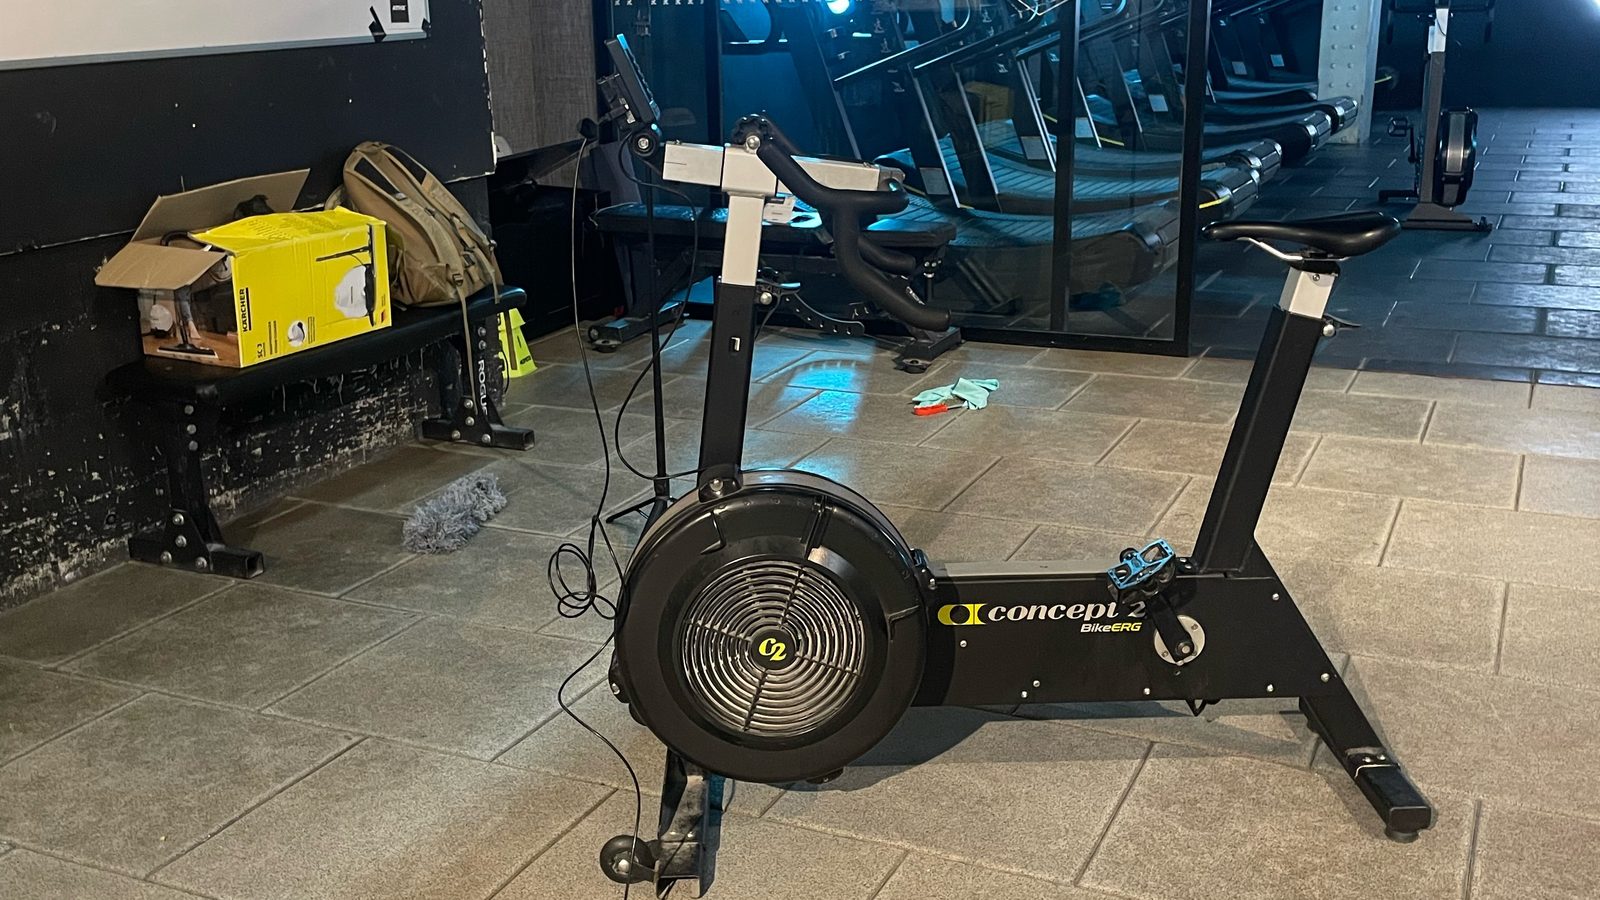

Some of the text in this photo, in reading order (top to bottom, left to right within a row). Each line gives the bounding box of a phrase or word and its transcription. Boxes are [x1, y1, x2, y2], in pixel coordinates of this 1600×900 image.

[988, 600, 1146, 621] concept 2
[1080, 622, 1142, 633] BikeERG
